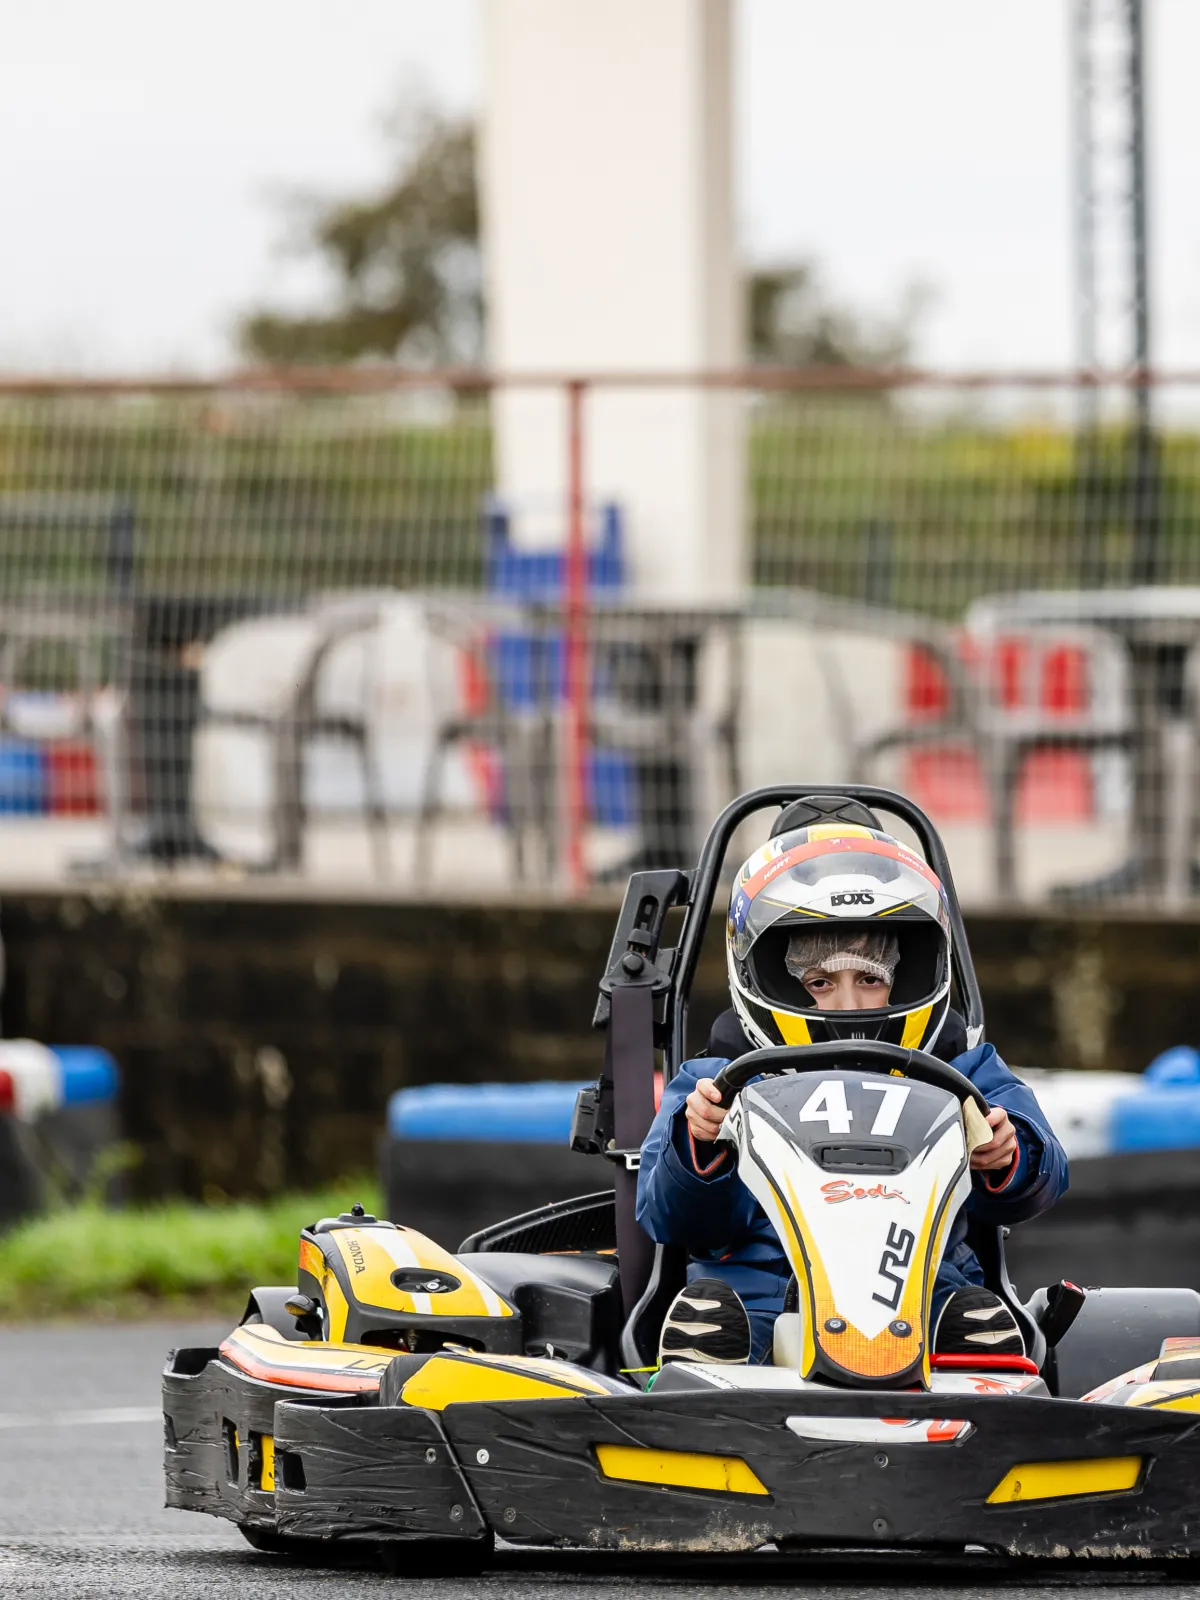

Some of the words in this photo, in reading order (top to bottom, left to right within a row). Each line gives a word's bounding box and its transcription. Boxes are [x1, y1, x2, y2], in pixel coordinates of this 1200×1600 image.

[798, 1079, 912, 1137] 47
[346, 1240, 366, 1276] HONDA
[871, 1220, 916, 1312] LRS
